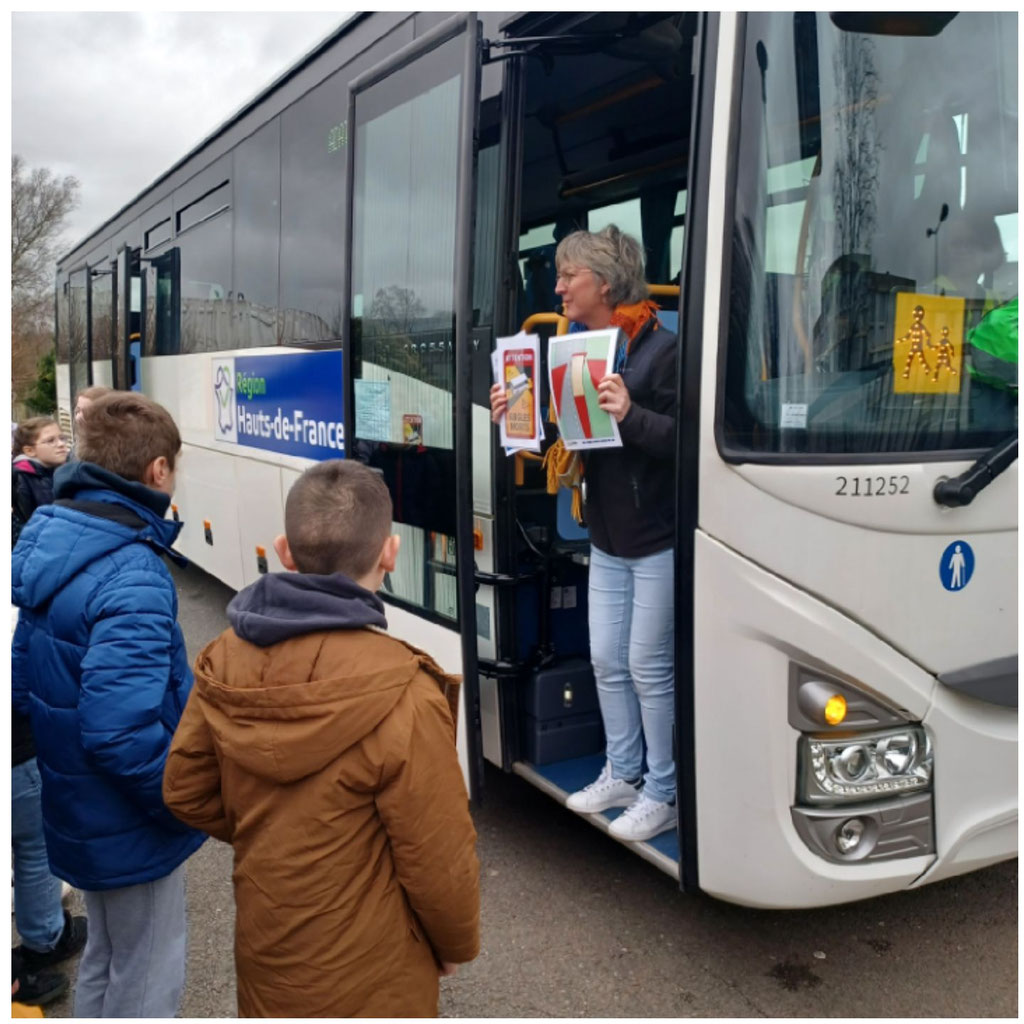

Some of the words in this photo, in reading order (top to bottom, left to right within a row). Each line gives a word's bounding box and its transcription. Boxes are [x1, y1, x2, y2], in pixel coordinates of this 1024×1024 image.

[237, 371, 266, 400] Région
[237, 405, 345, 450] Hauts-de-France
[835, 475, 910, 497] 211252
